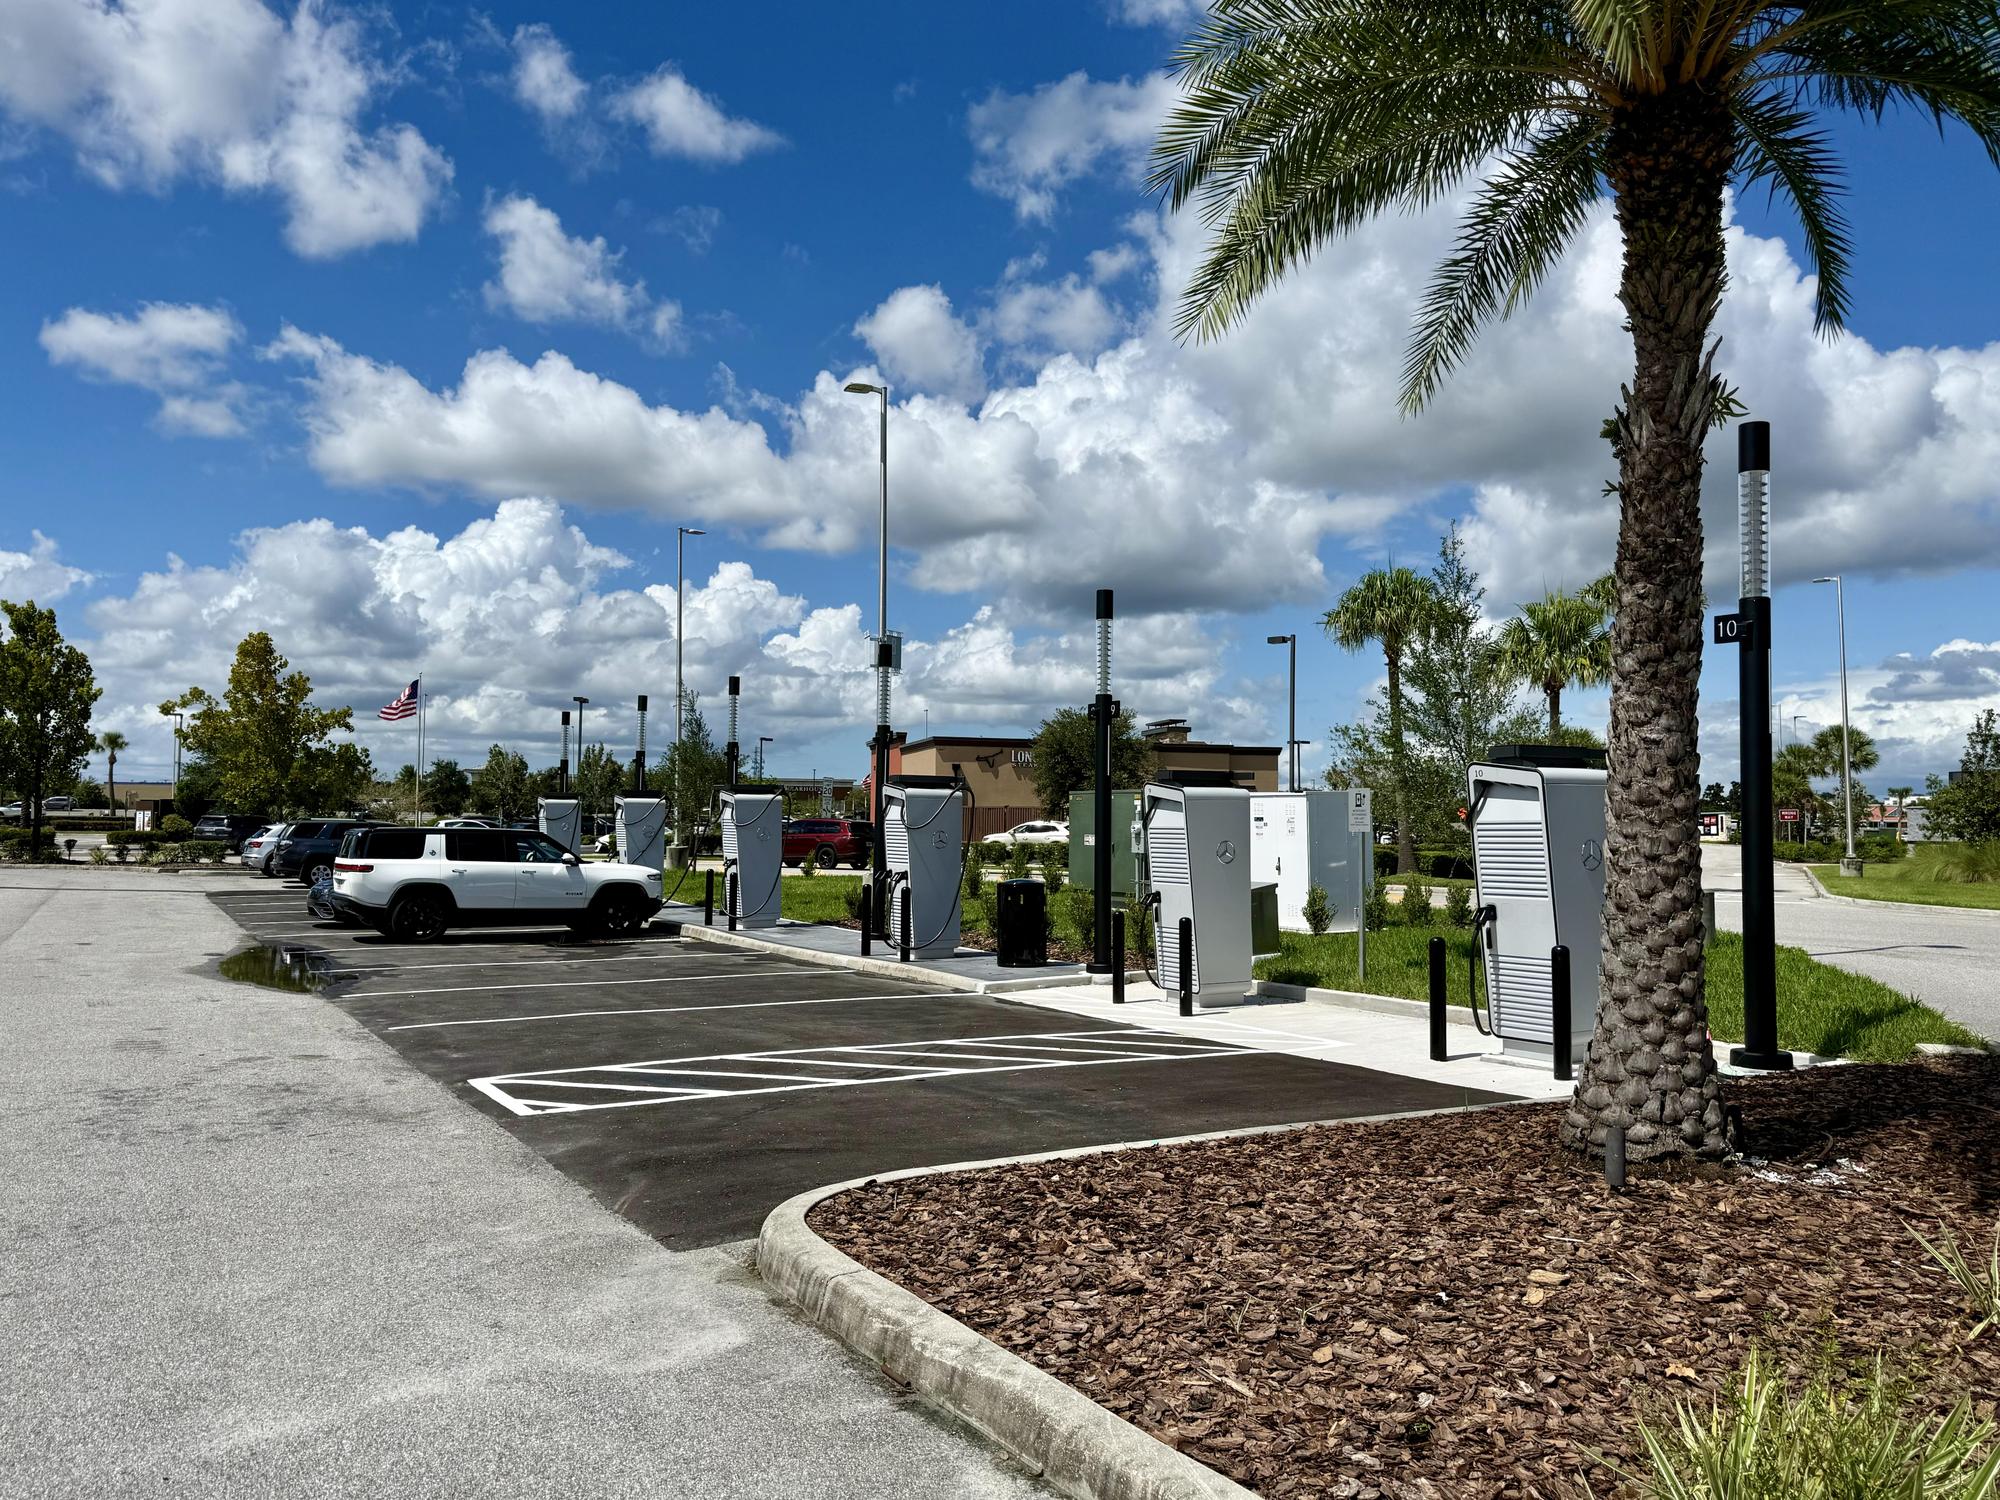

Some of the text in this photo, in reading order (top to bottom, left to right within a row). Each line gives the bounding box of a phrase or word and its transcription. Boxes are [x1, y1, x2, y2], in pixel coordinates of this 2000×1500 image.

[1718, 620, 1736, 638] 10
[1110, 704, 1116, 715] 9
[1011, 750, 1035, 763] LON
[1474, 770, 1484, 778] 10
